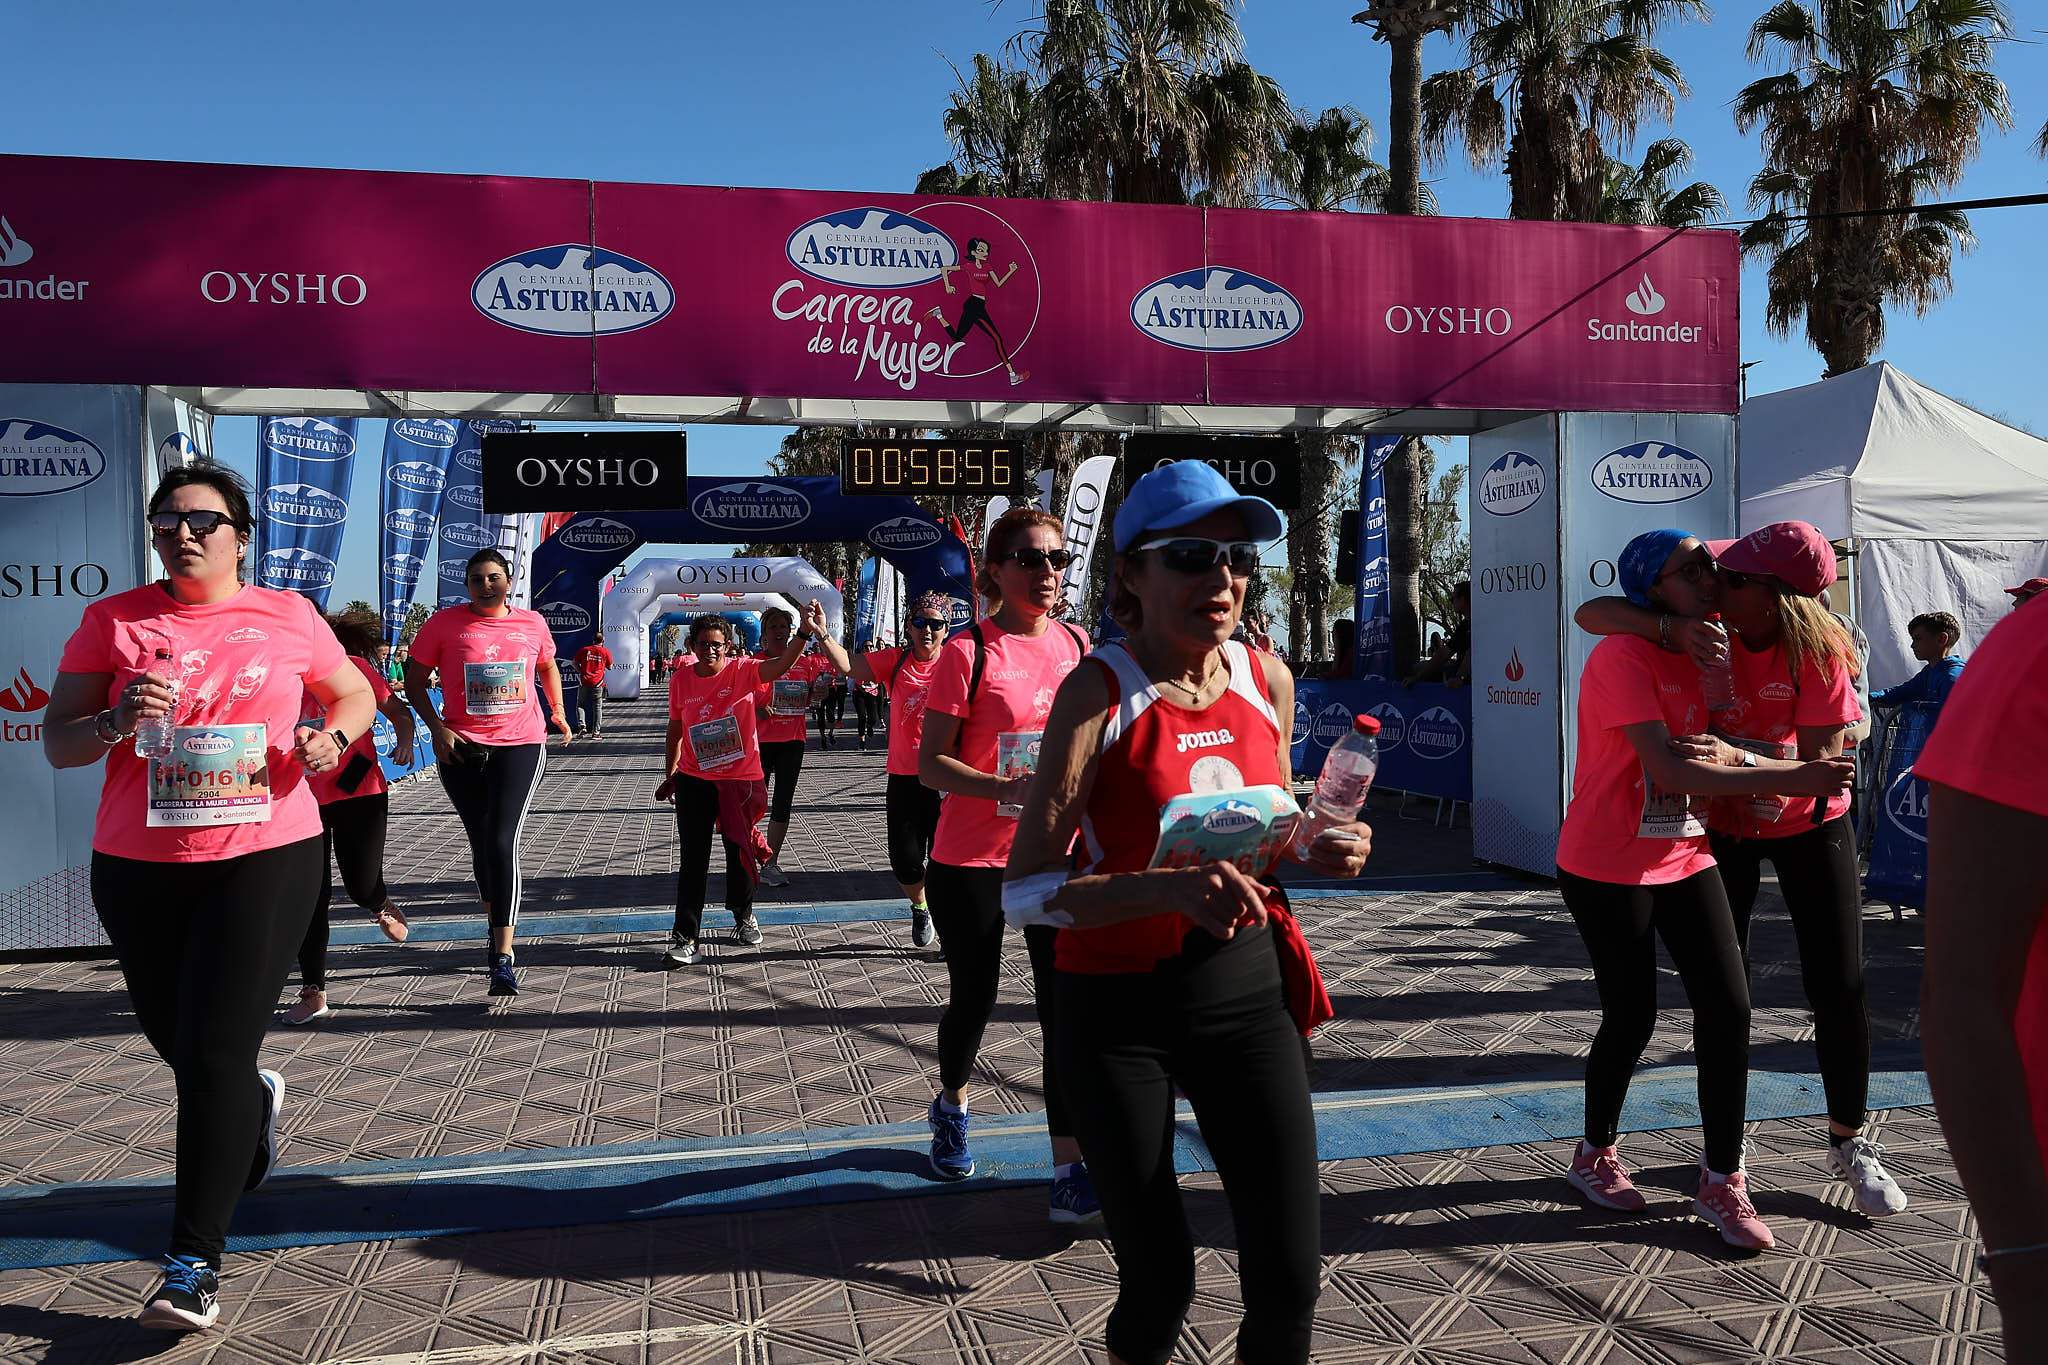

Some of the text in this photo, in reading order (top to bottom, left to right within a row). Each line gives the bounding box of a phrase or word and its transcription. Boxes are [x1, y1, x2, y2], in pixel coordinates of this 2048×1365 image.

[826, 233, 941, 246] CENTRAL LECHERA
[800, 234, 944, 270] ASTURIANA
[200, 270, 368, 306] OYSHO
[519, 275, 583, 285] CENTRAL
[487, 276, 660, 314] ASTURIANA
[771, 279, 914, 325] Carrera
[1170, 295, 1285, 306] CENTRAL LECHERA
[1144, 296, 1290, 330] ASTURIANA
[1385, 305, 1513, 336] OYSHO
[807, 325, 858, 355] de la
[1587, 318, 1702, 343] Santander
[854, 321, 967, 391] Mujer
[29, 446, 87, 454] LECHERA
[266, 426, 348, 454] ASTURIANA
[516, 458, 659, 487] OYSHO
[855, 448, 1010, 485] 00:58:56
[1600, 464, 1703, 489] ASTURIANA
[1618, 462, 1657, 470] CENTRAL
[1483, 477, 1541, 504] ASTURIANA
[265, 496, 343, 521] ASTURIANA
[701, 500, 802, 518] ASTURIANA
[563, 529, 630, 544] ASTURIANA
[874, 528, 938, 543] ASTURIANA
[1, 563, 109, 598] SHO
[261, 560, 333, 583] ASTURIANA
[676, 564, 772, 585] OYSHO
[1480, 562, 1547, 594] OYSHO
[619, 586, 649, 594] OYSHO
[607, 624, 635, 632] OYSHO
[1487, 686, 1541, 706] Santander
[186, 741, 232, 751] ASTURIANA
[1411, 725, 1458, 748] ASTURIANA
[187, 769, 233, 788] 016
[185, 800, 194, 808] DE
[195, 799, 205, 807] LA
[206, 799, 228, 807] MUJER
[233, 797, 263, 805] VALENCIA
[198, 790, 220, 799] 2904
[162, 810, 257, 821] OYSHO Santander
[1206, 812, 1259, 829] ASTURIANA
[1649, 825, 1678, 833] OYSHO
